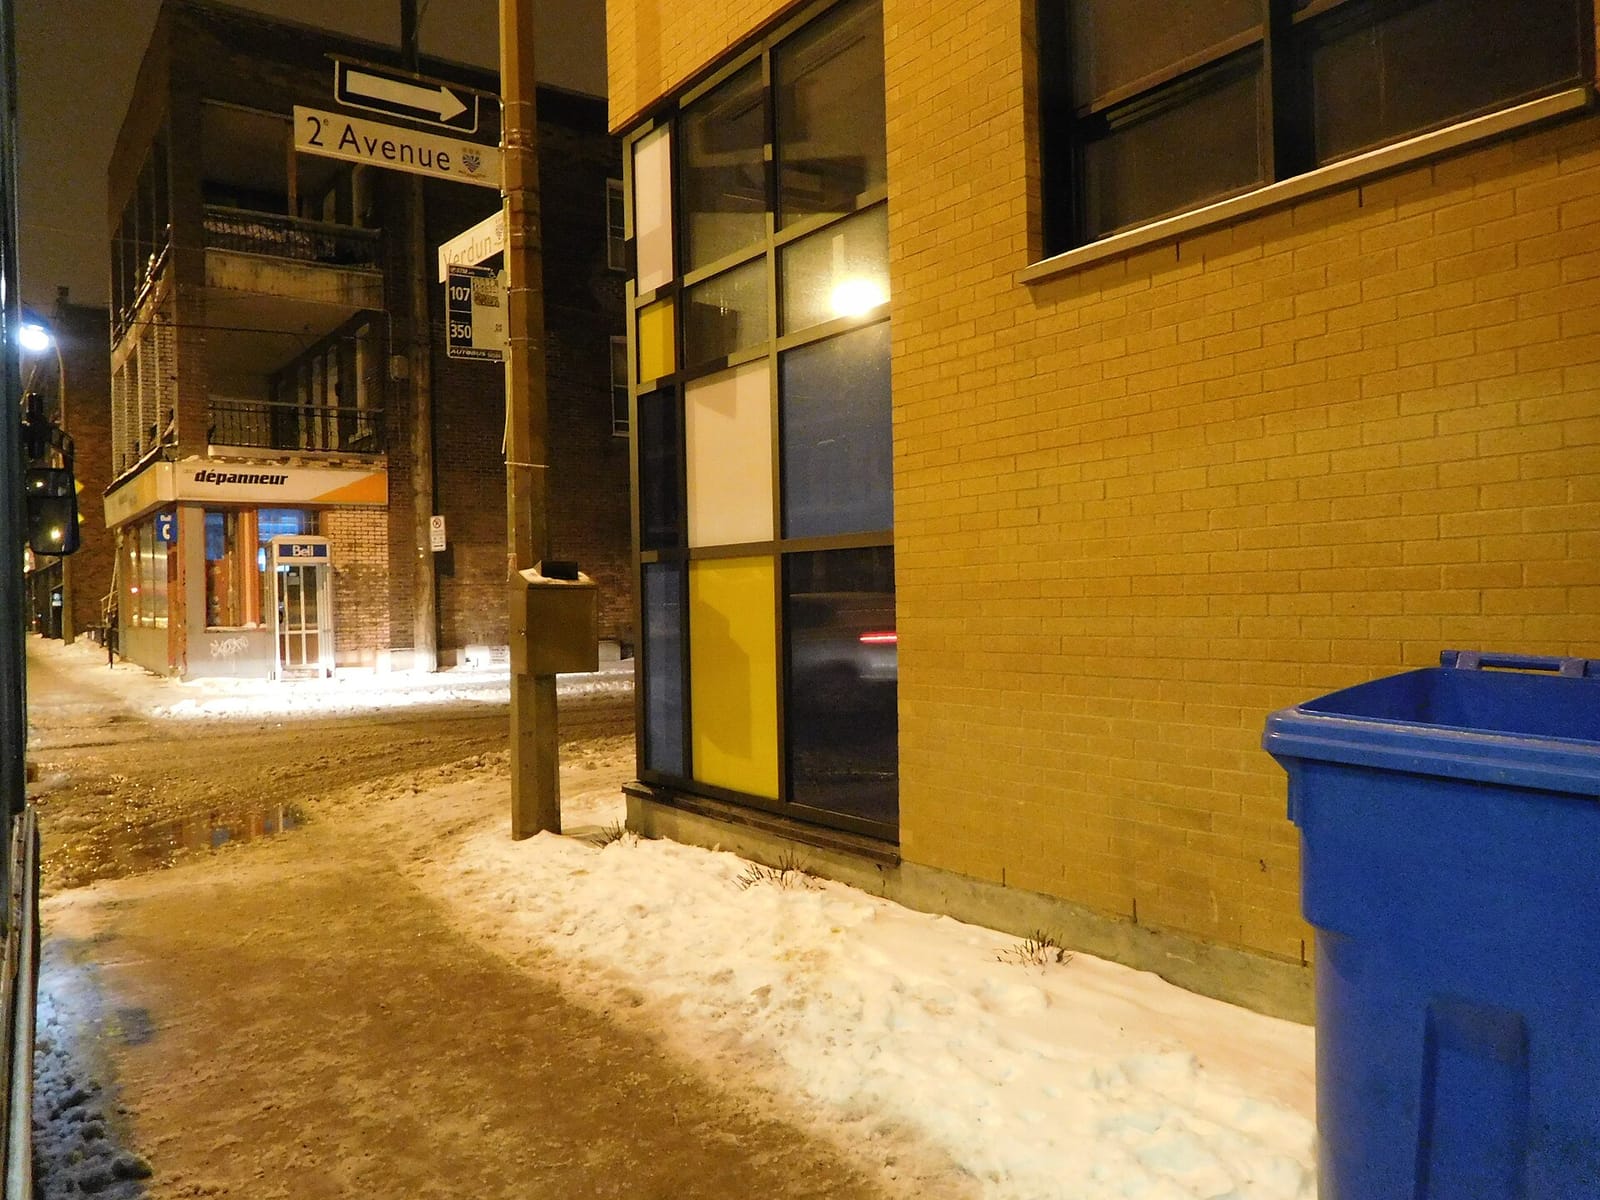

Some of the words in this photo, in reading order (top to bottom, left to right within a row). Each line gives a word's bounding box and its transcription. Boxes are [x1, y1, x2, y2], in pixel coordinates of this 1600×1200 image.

[338, 123, 450, 171] Avenue
[443, 235, 492, 266] Verdun
[449, 286, 471, 302] 107
[450, 324, 471, 339] 350
[194, 469, 288, 485] dépanneur
[292, 544, 314, 556] Bell
